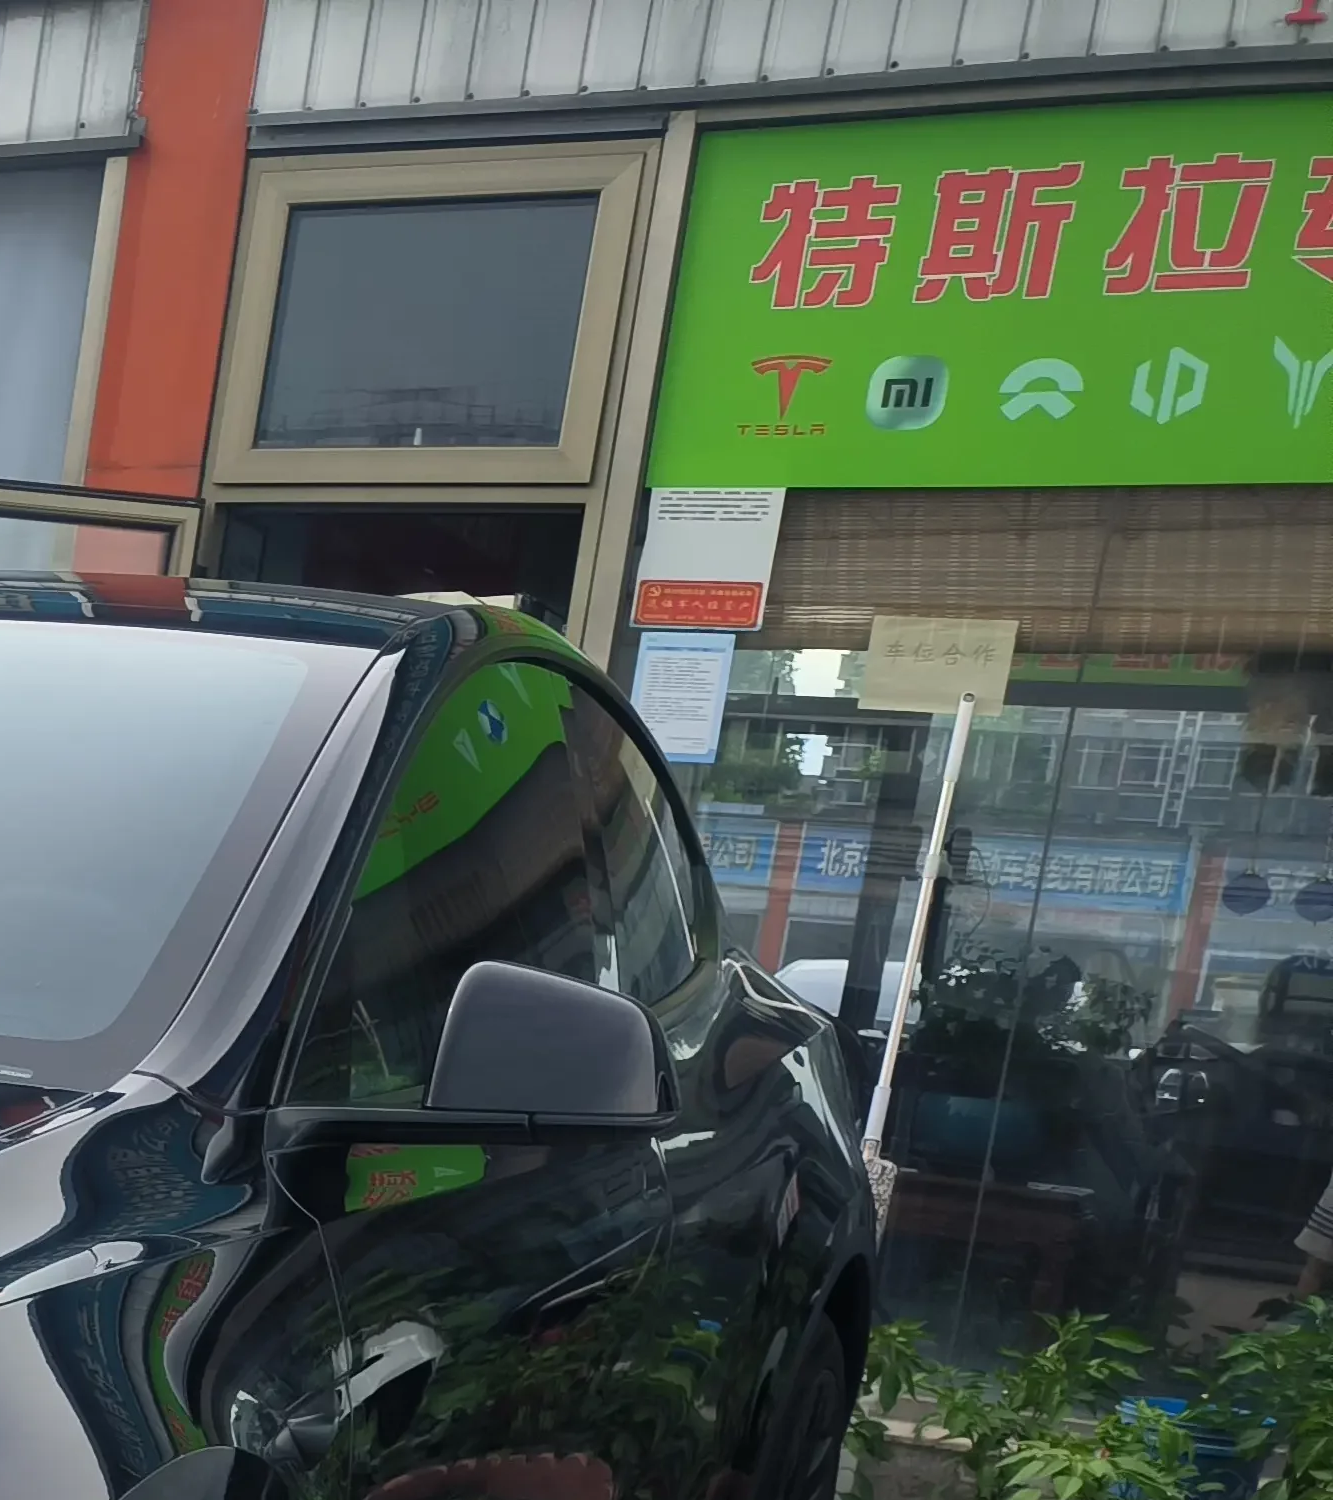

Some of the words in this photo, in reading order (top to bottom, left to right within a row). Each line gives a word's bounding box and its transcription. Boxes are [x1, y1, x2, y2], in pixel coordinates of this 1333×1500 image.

[749, 152, 1333, 309] 特斯拉
[736, 423, 827, 437] TESLA
[884, 640, 997, 669] 车位合作
